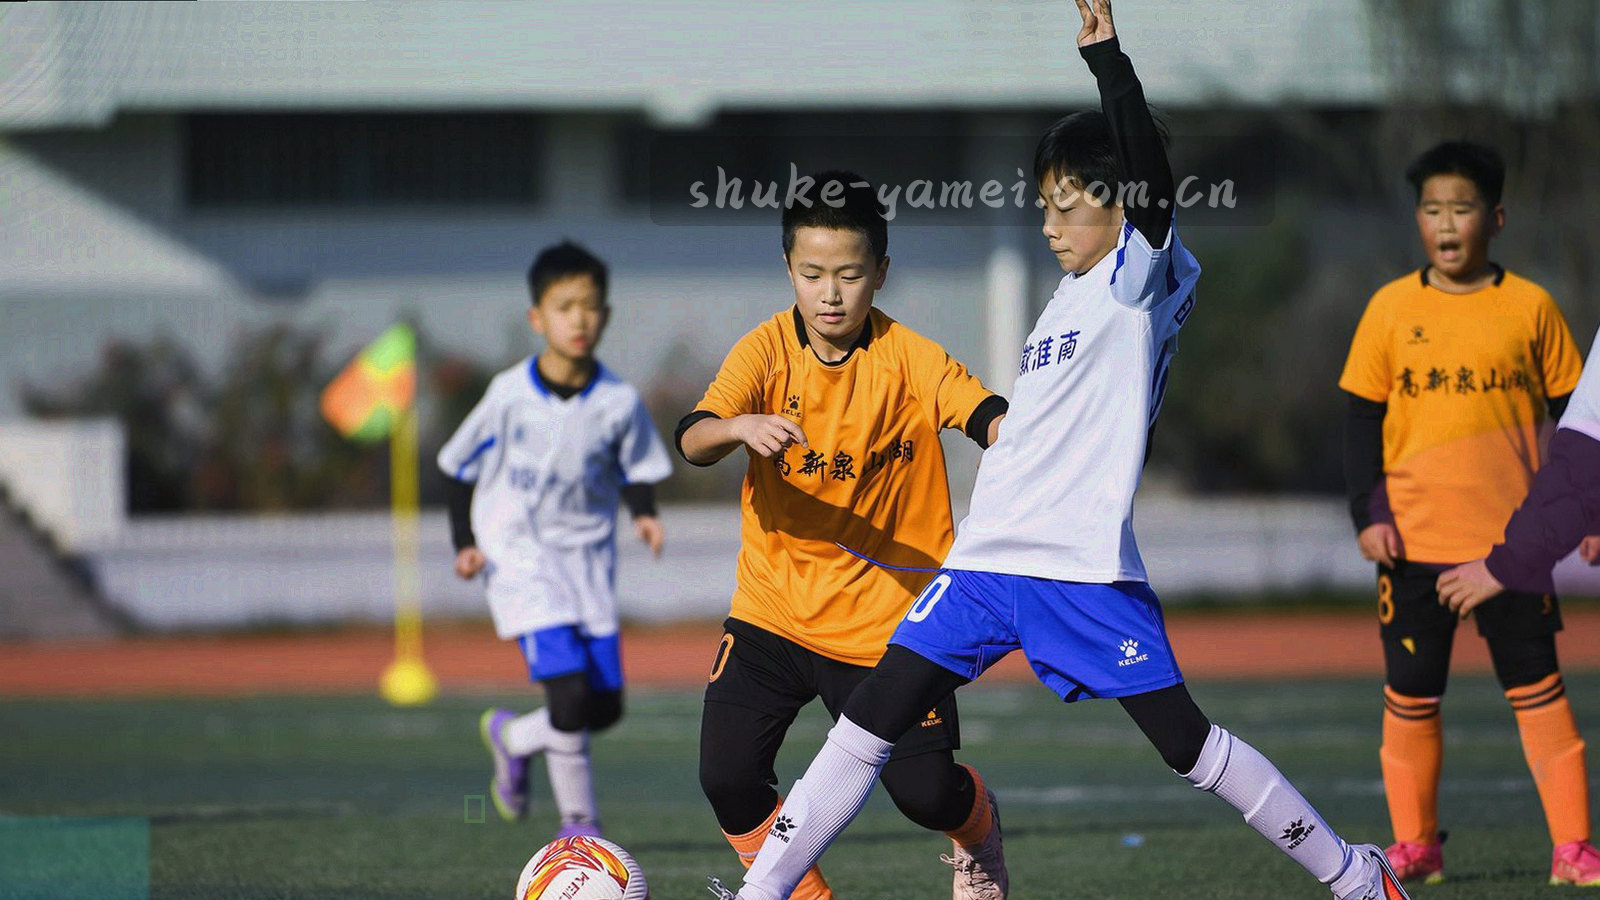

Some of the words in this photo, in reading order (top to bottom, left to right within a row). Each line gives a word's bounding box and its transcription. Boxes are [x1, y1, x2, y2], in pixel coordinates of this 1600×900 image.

[1378, 574, 1394, 624] 8
[1118, 653, 1149, 667] KELME
[1287, 823, 1315, 850] KELME
